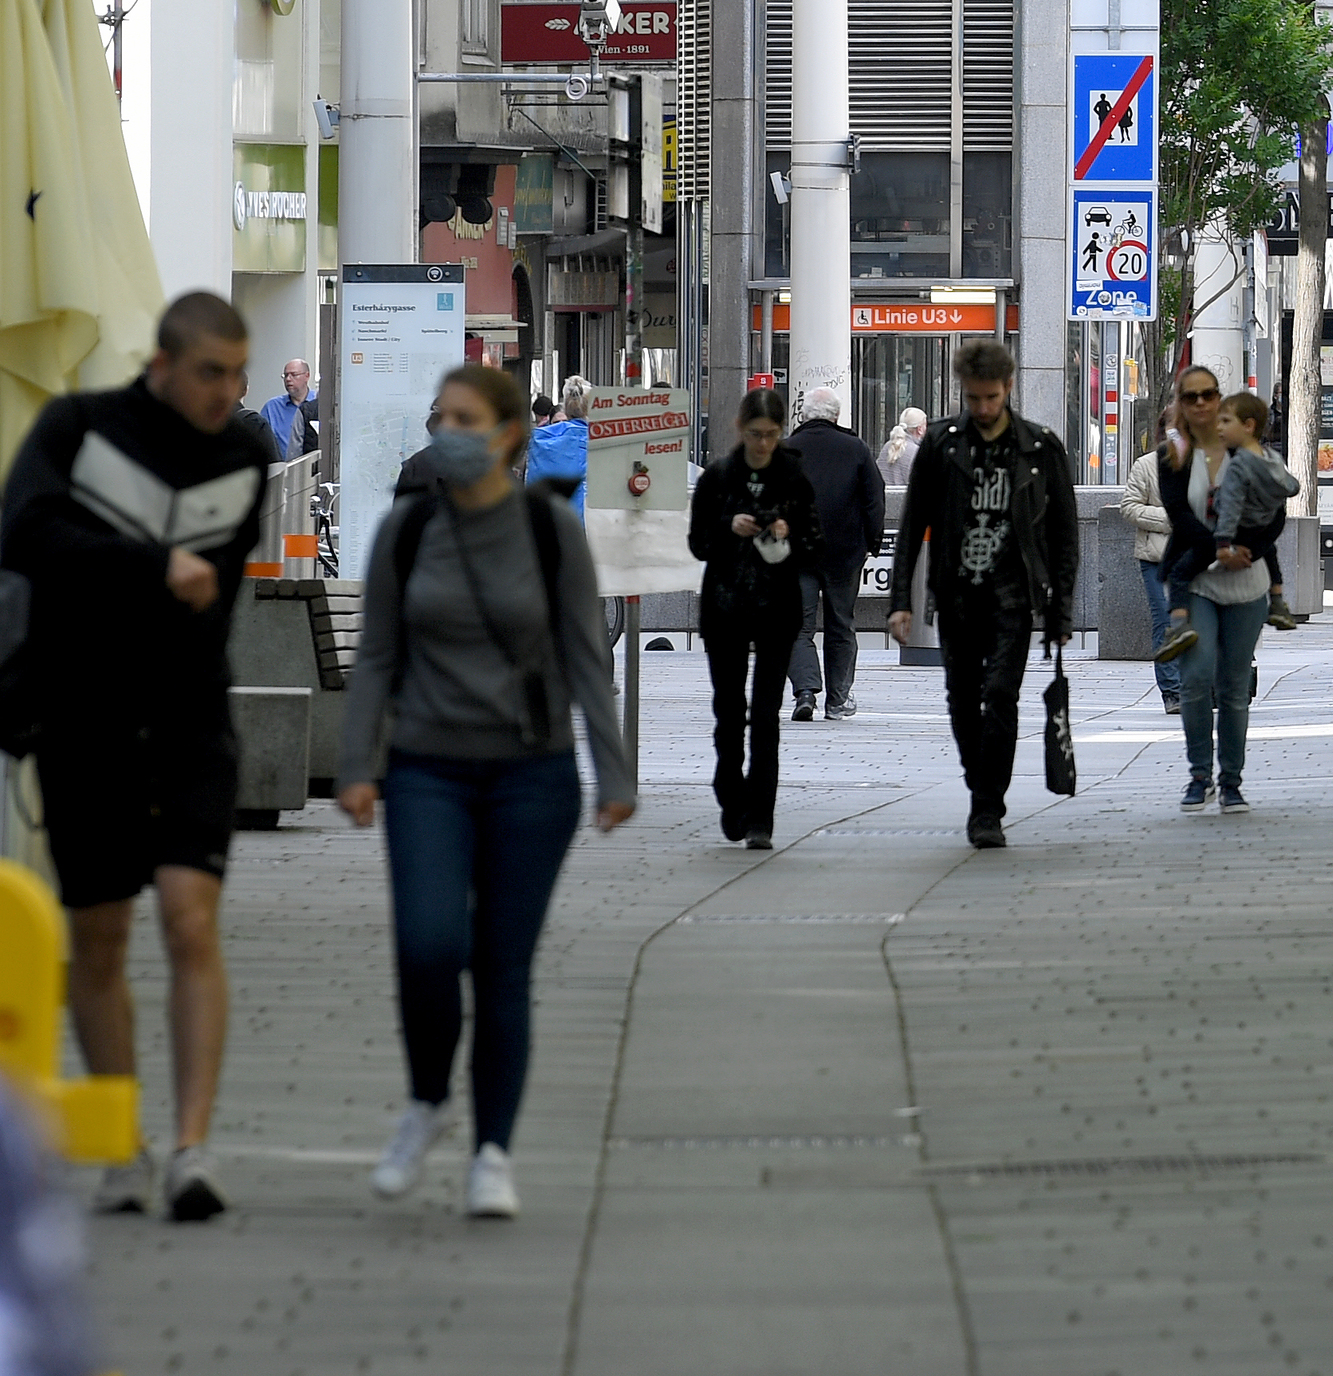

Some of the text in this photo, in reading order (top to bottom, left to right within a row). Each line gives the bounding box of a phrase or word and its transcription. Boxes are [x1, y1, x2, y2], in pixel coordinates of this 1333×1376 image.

[573, 12, 671, 36] KER
[627, 45, 650, 54] 1891
[270, 191, 307, 219] ROCHER
[1118, 253, 1143, 275] 20
[352, 303, 417, 315] Esterházygasse
[874, 308, 948, 325] Linie U3
[592, 392, 671, 410] Am Sonntag
[644, 439, 683, 455] lesen!
